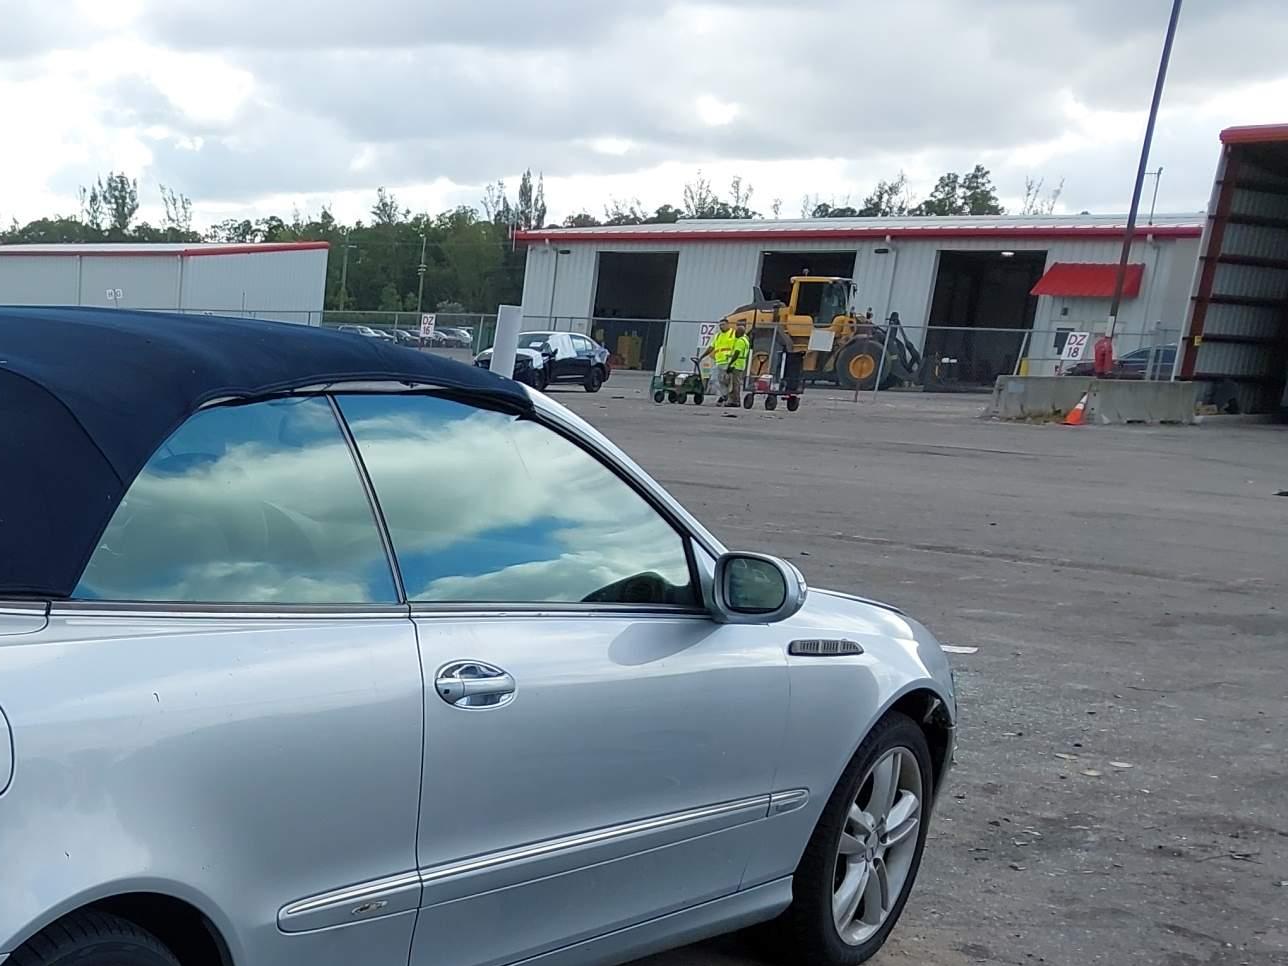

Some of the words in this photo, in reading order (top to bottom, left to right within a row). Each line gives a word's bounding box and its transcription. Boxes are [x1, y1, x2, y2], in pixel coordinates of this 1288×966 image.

[423, 316, 434, 326] DZ
[701, 324, 715, 336] DZ
[1068, 334, 1087, 346] DZ
[1067, 346, 1080, 358] 18
